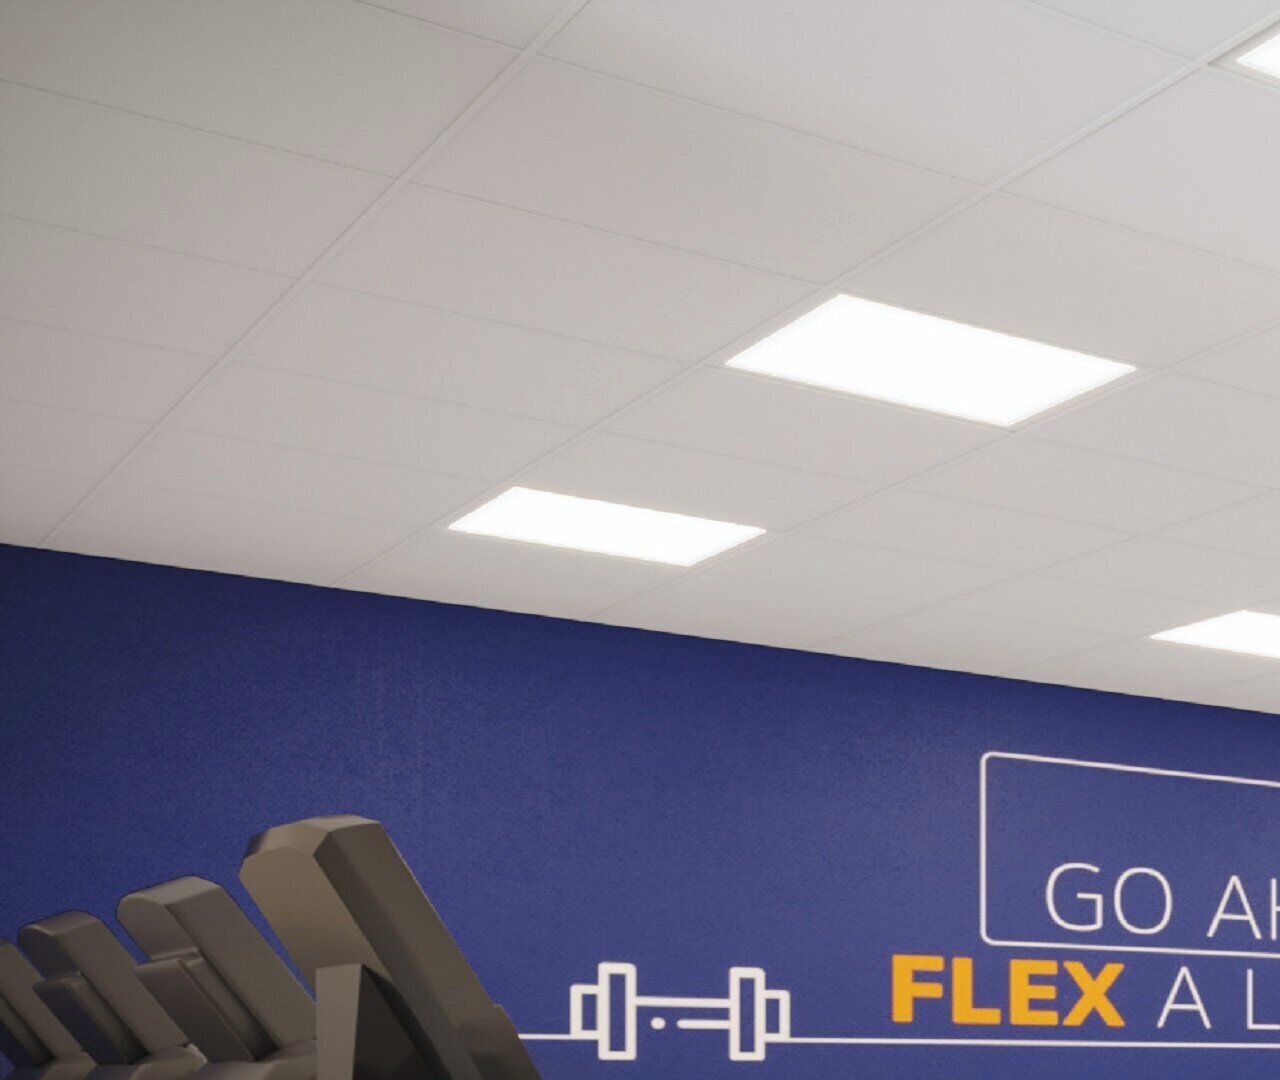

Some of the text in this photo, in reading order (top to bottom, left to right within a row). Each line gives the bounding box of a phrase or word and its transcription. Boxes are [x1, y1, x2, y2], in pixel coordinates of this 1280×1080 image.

[1045, 862, 1173, 934] GO
[891, 954, 1125, 1027] FLEX
[1156, 966, 1212, 1029] A
